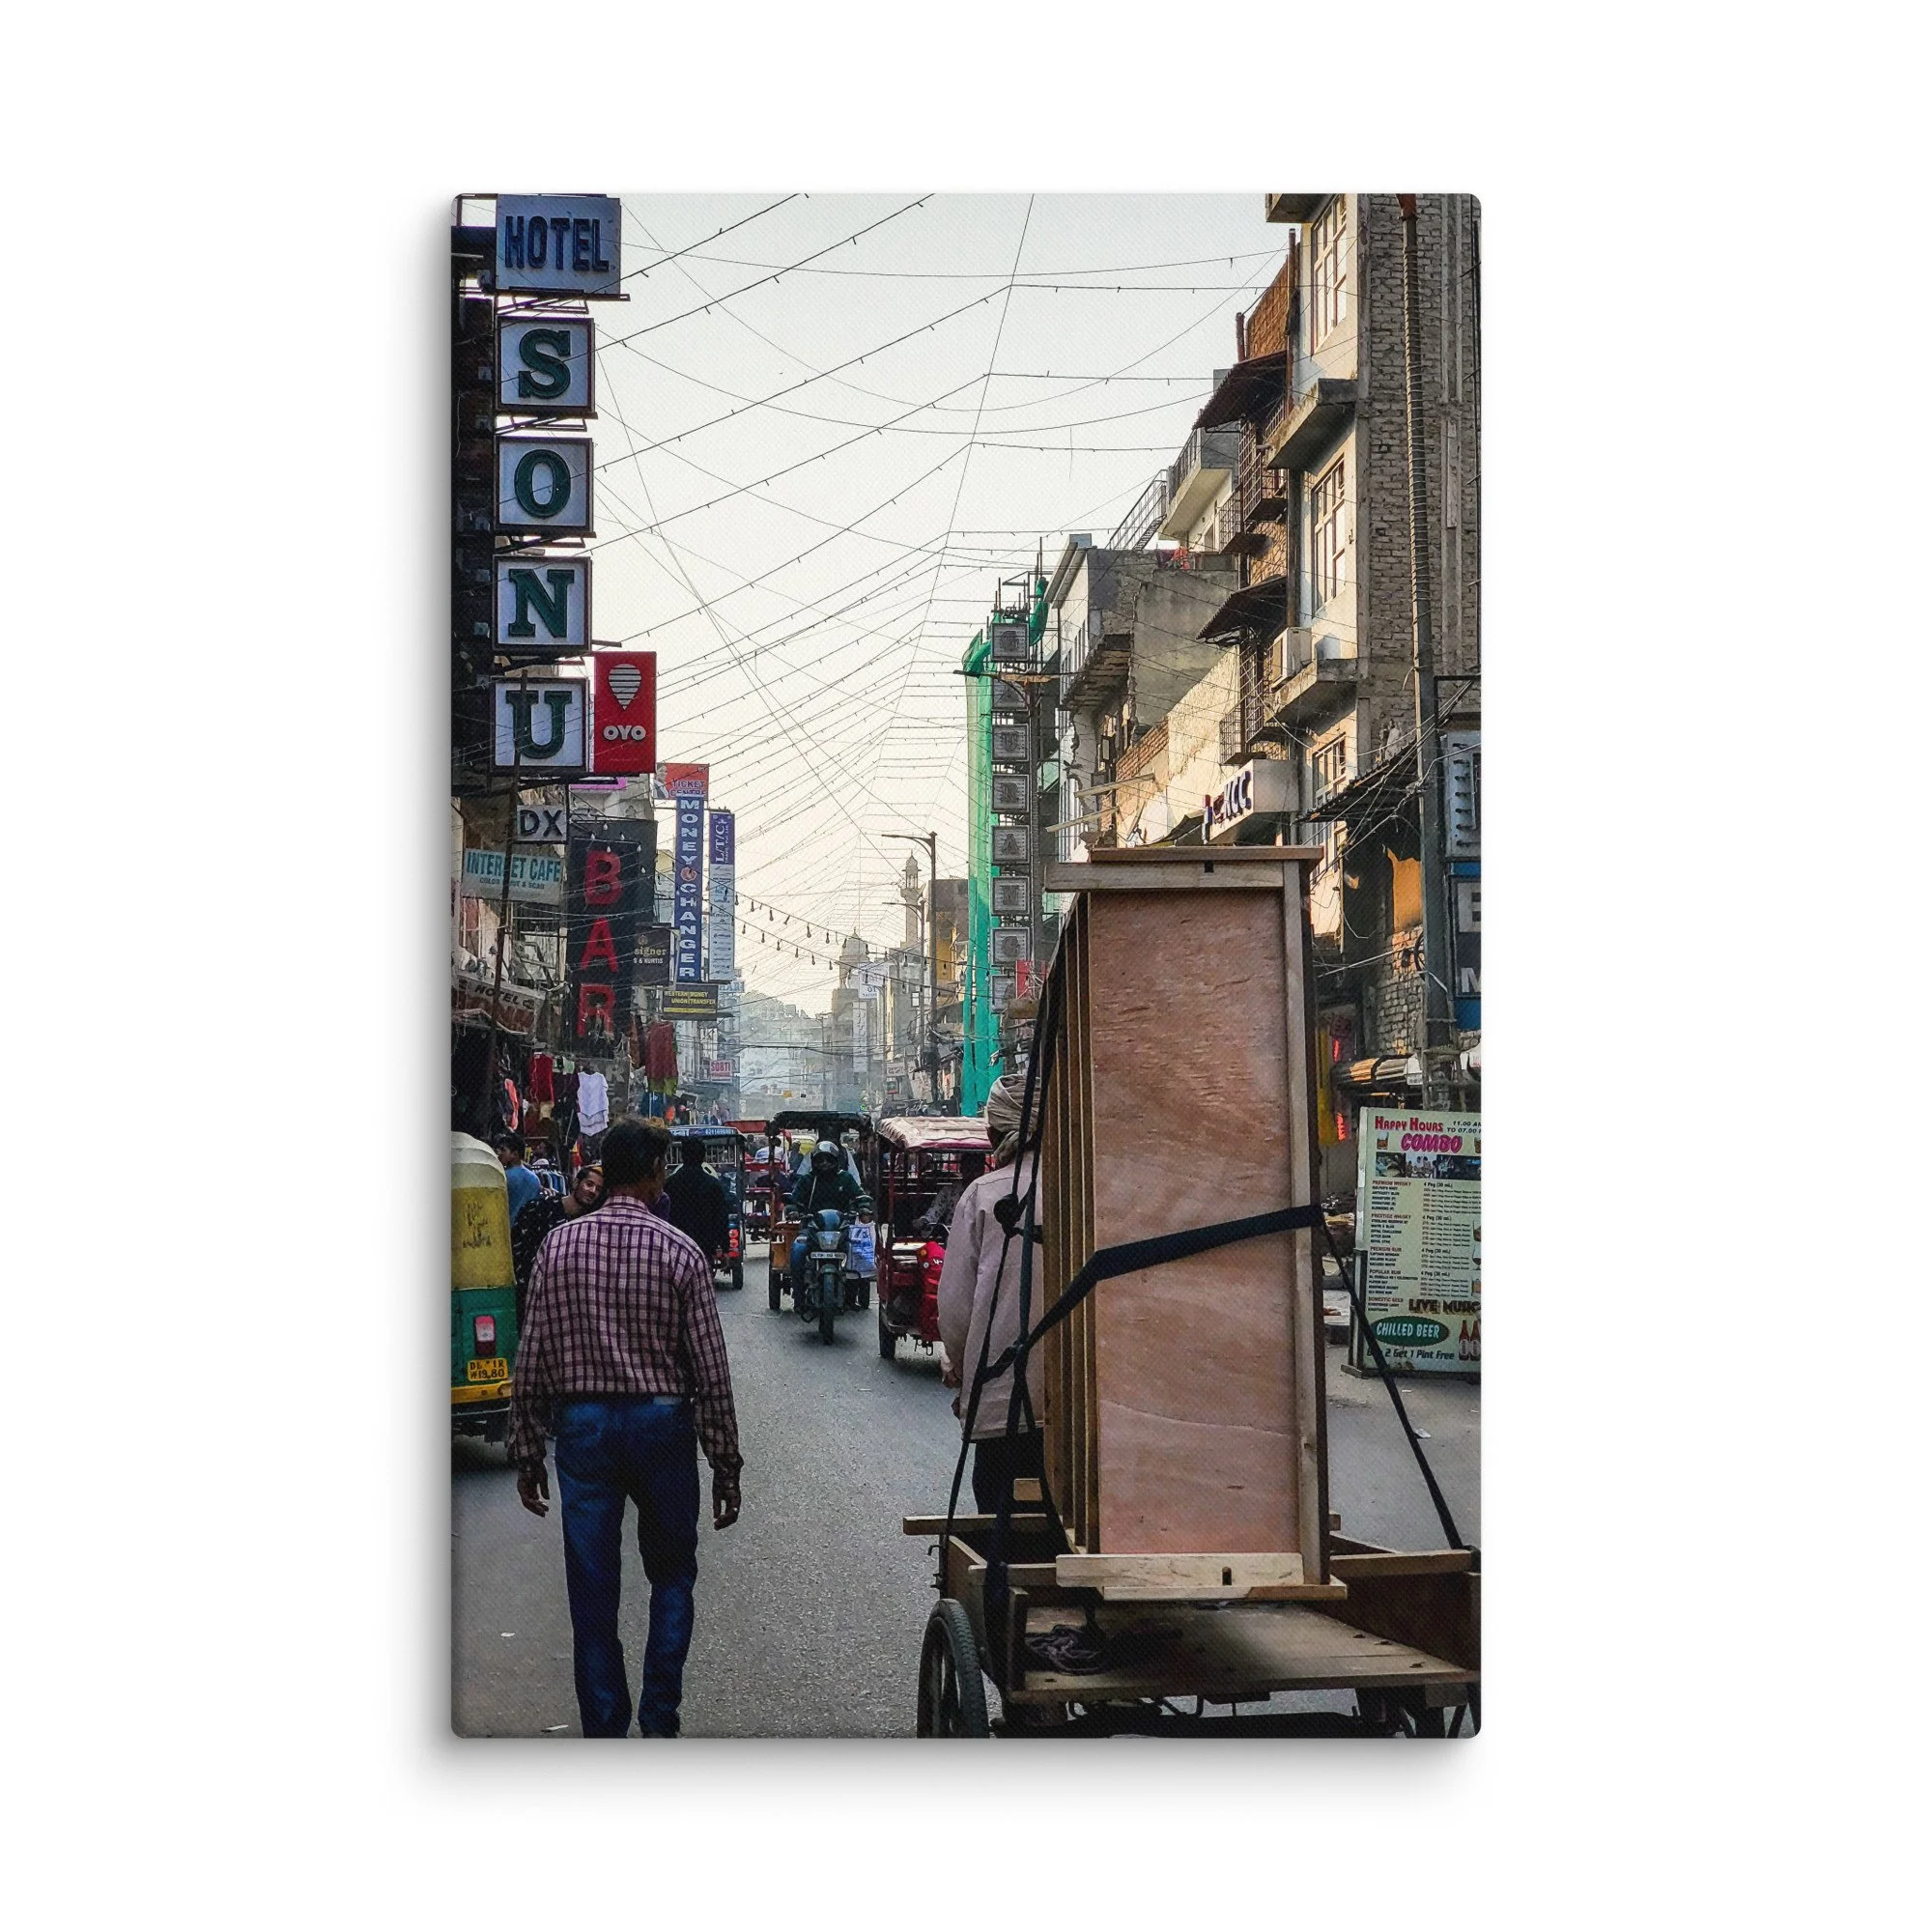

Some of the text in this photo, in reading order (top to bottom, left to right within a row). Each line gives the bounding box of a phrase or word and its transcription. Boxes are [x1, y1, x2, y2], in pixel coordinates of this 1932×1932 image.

[505, 215, 609, 272] HOTEL
[603, 724, 646, 741] OYO
[672, 780, 705, 789] TICKET
[519, 810, 563, 837] DX
[467, 852, 560, 882] INTERET CAFE
[1401, 1133, 1463, 1153] COMBO
[1408, 1298, 1440, 1314] LIVE
[1376, 1322, 1439, 1338] CHILLED BEER
[1416, 1350, 1434, 1359] Pint
[1435, 1350, 1455, 1360] Free
